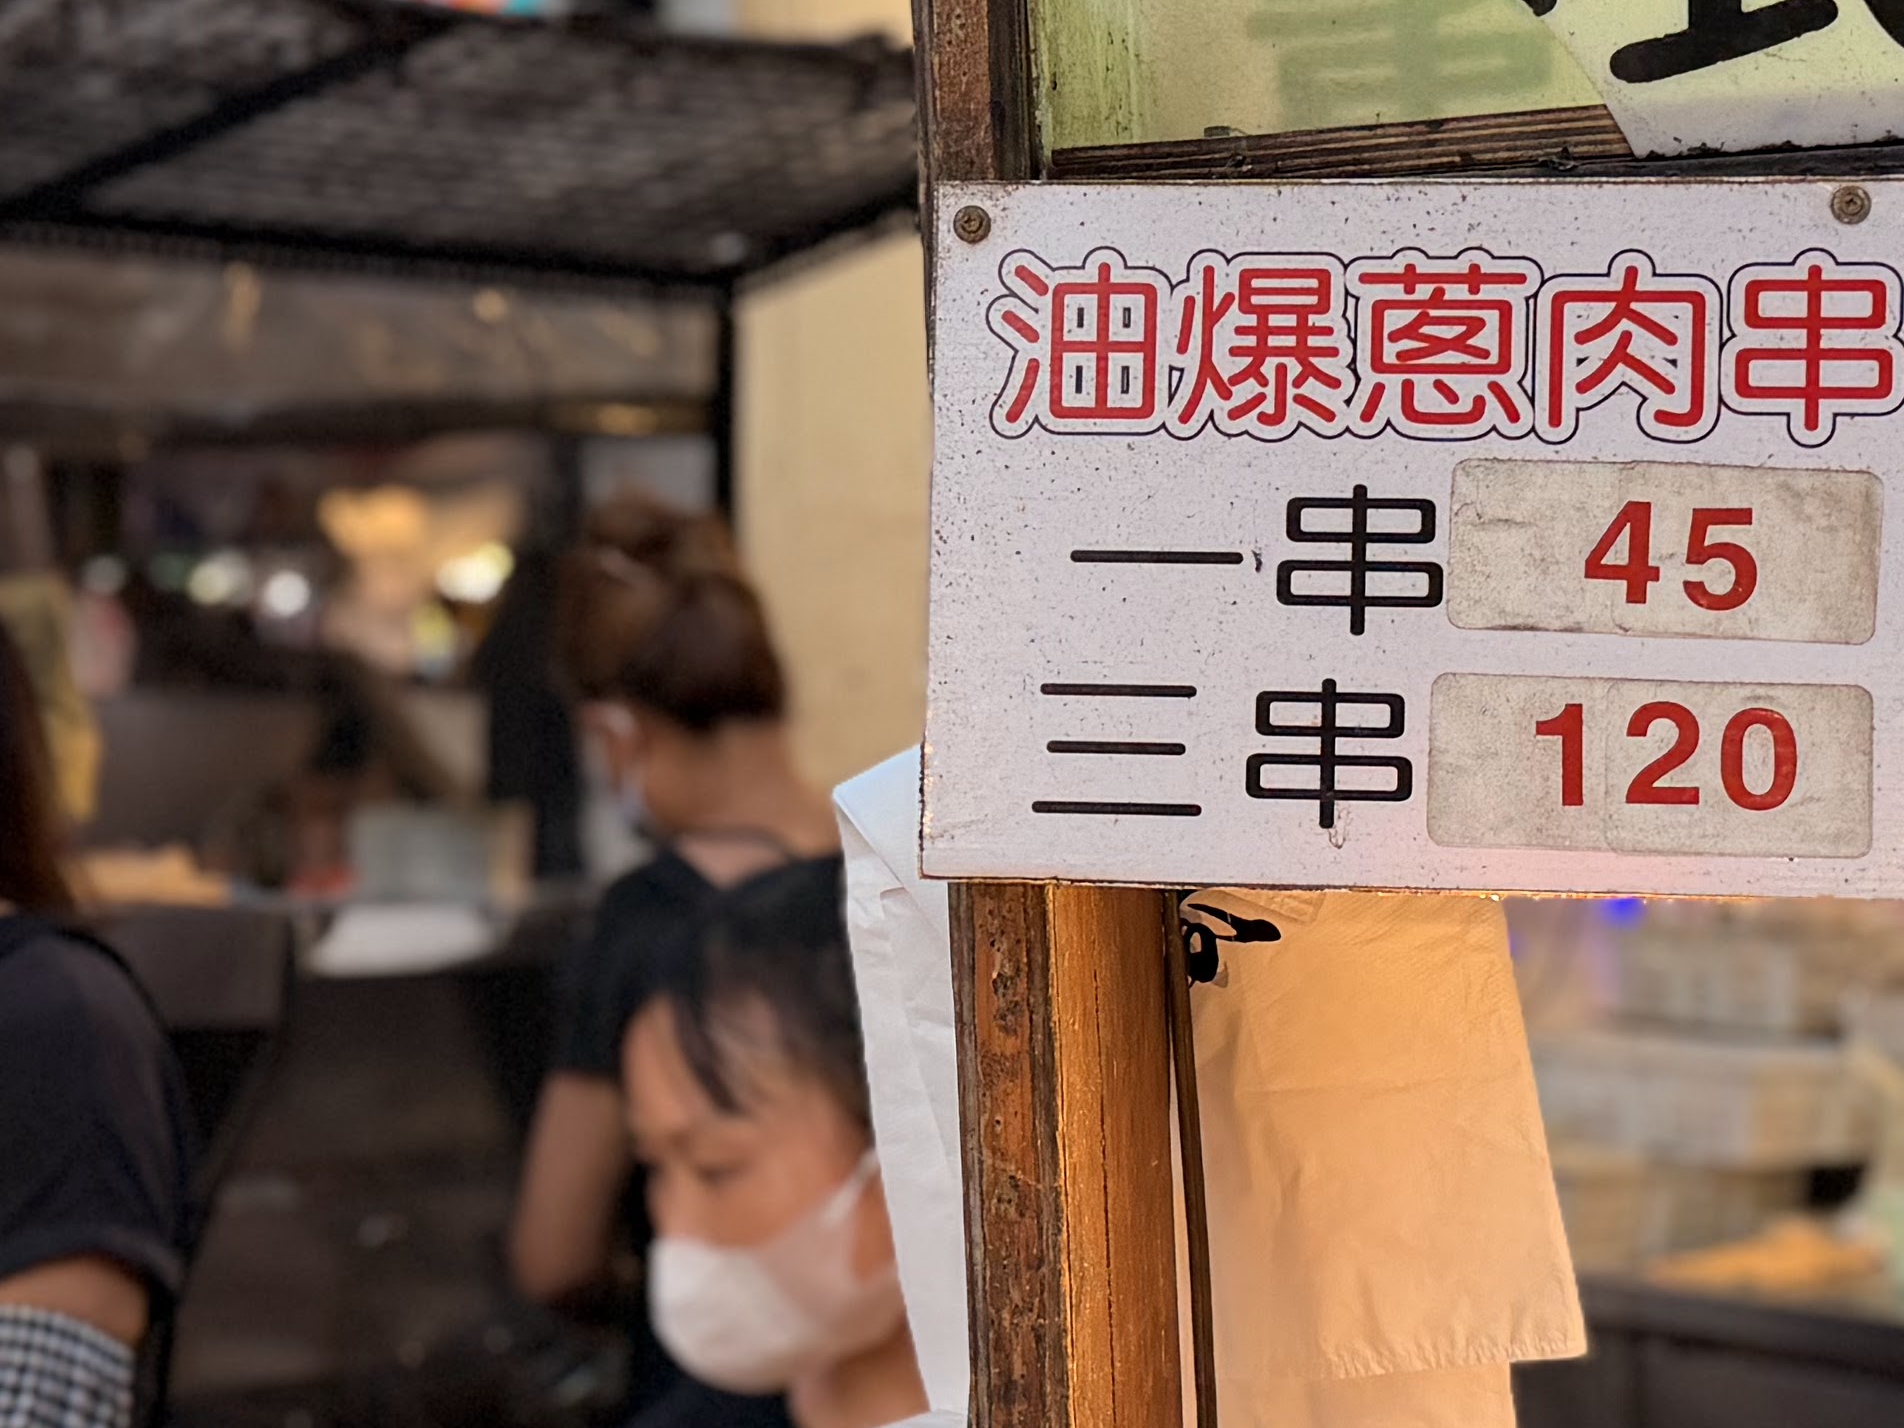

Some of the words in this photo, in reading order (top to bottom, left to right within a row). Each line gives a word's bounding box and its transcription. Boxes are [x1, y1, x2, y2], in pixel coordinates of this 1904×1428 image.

[1068, 484, 1444, 636] 一串
[1582, 500, 1760, 612] 45
[1030, 678, 1414, 830] 三串
[1534, 700, 1798, 810] 120
